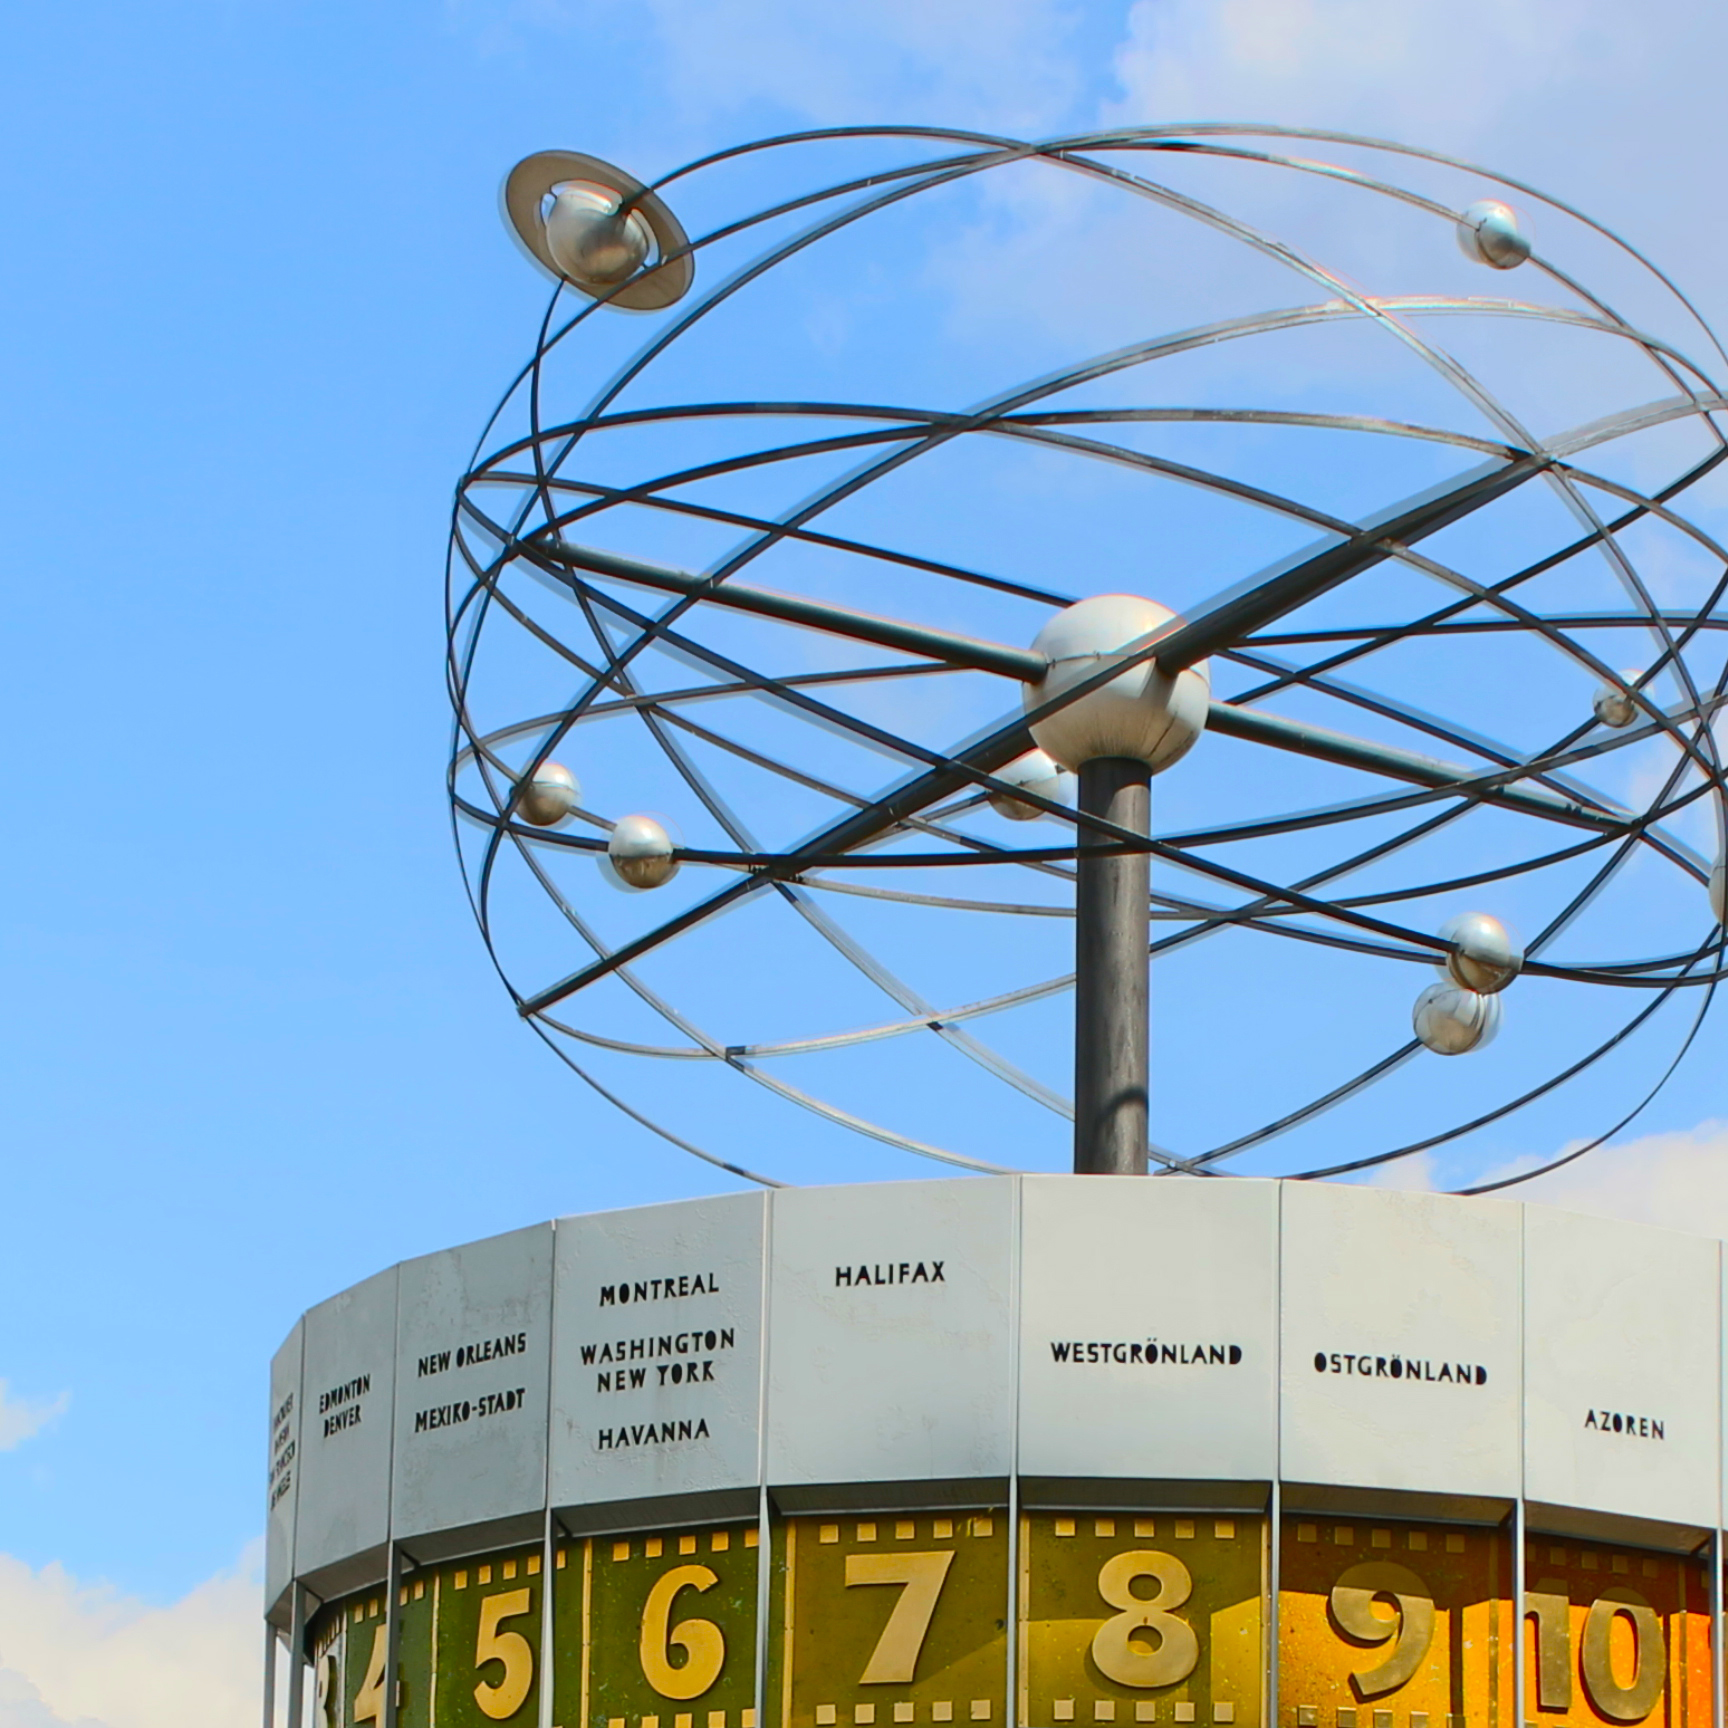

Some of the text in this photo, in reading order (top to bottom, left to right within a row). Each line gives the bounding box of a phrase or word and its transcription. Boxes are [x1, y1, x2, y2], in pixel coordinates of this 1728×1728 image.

[600, 1272, 719, 1307] MONTREAL
[835, 1261, 945, 1287] HALIFAX
[418, 1332, 526, 1378] NEW ORLEANS
[580, 1328, 734, 1365] WASHINGTON
[1051, 1336, 1243, 1366] WESTGRÖNLAND
[597, 1360, 714, 1393] NEW YORK
[1314, 1353, 1487, 1386] OSTGRÖNLAND
[319, 1373, 371, 1414] EDMONTON
[415, 1388, 526, 1433] MEXIKO-STADT
[324, 1404, 362, 1438] DENVER
[598, 1418, 710, 1450] HAVANNA
[1585, 1409, 1665, 1441] AZOREN
[640, 1564, 726, 1700] 6
[845, 1550, 956, 1684] 7
[1092, 1550, 1198, 1688] 8
[1331, 1561, 1435, 1698] 9
[474, 1589, 534, 1720] 5
[1526, 1579, 1665, 1722] 10
